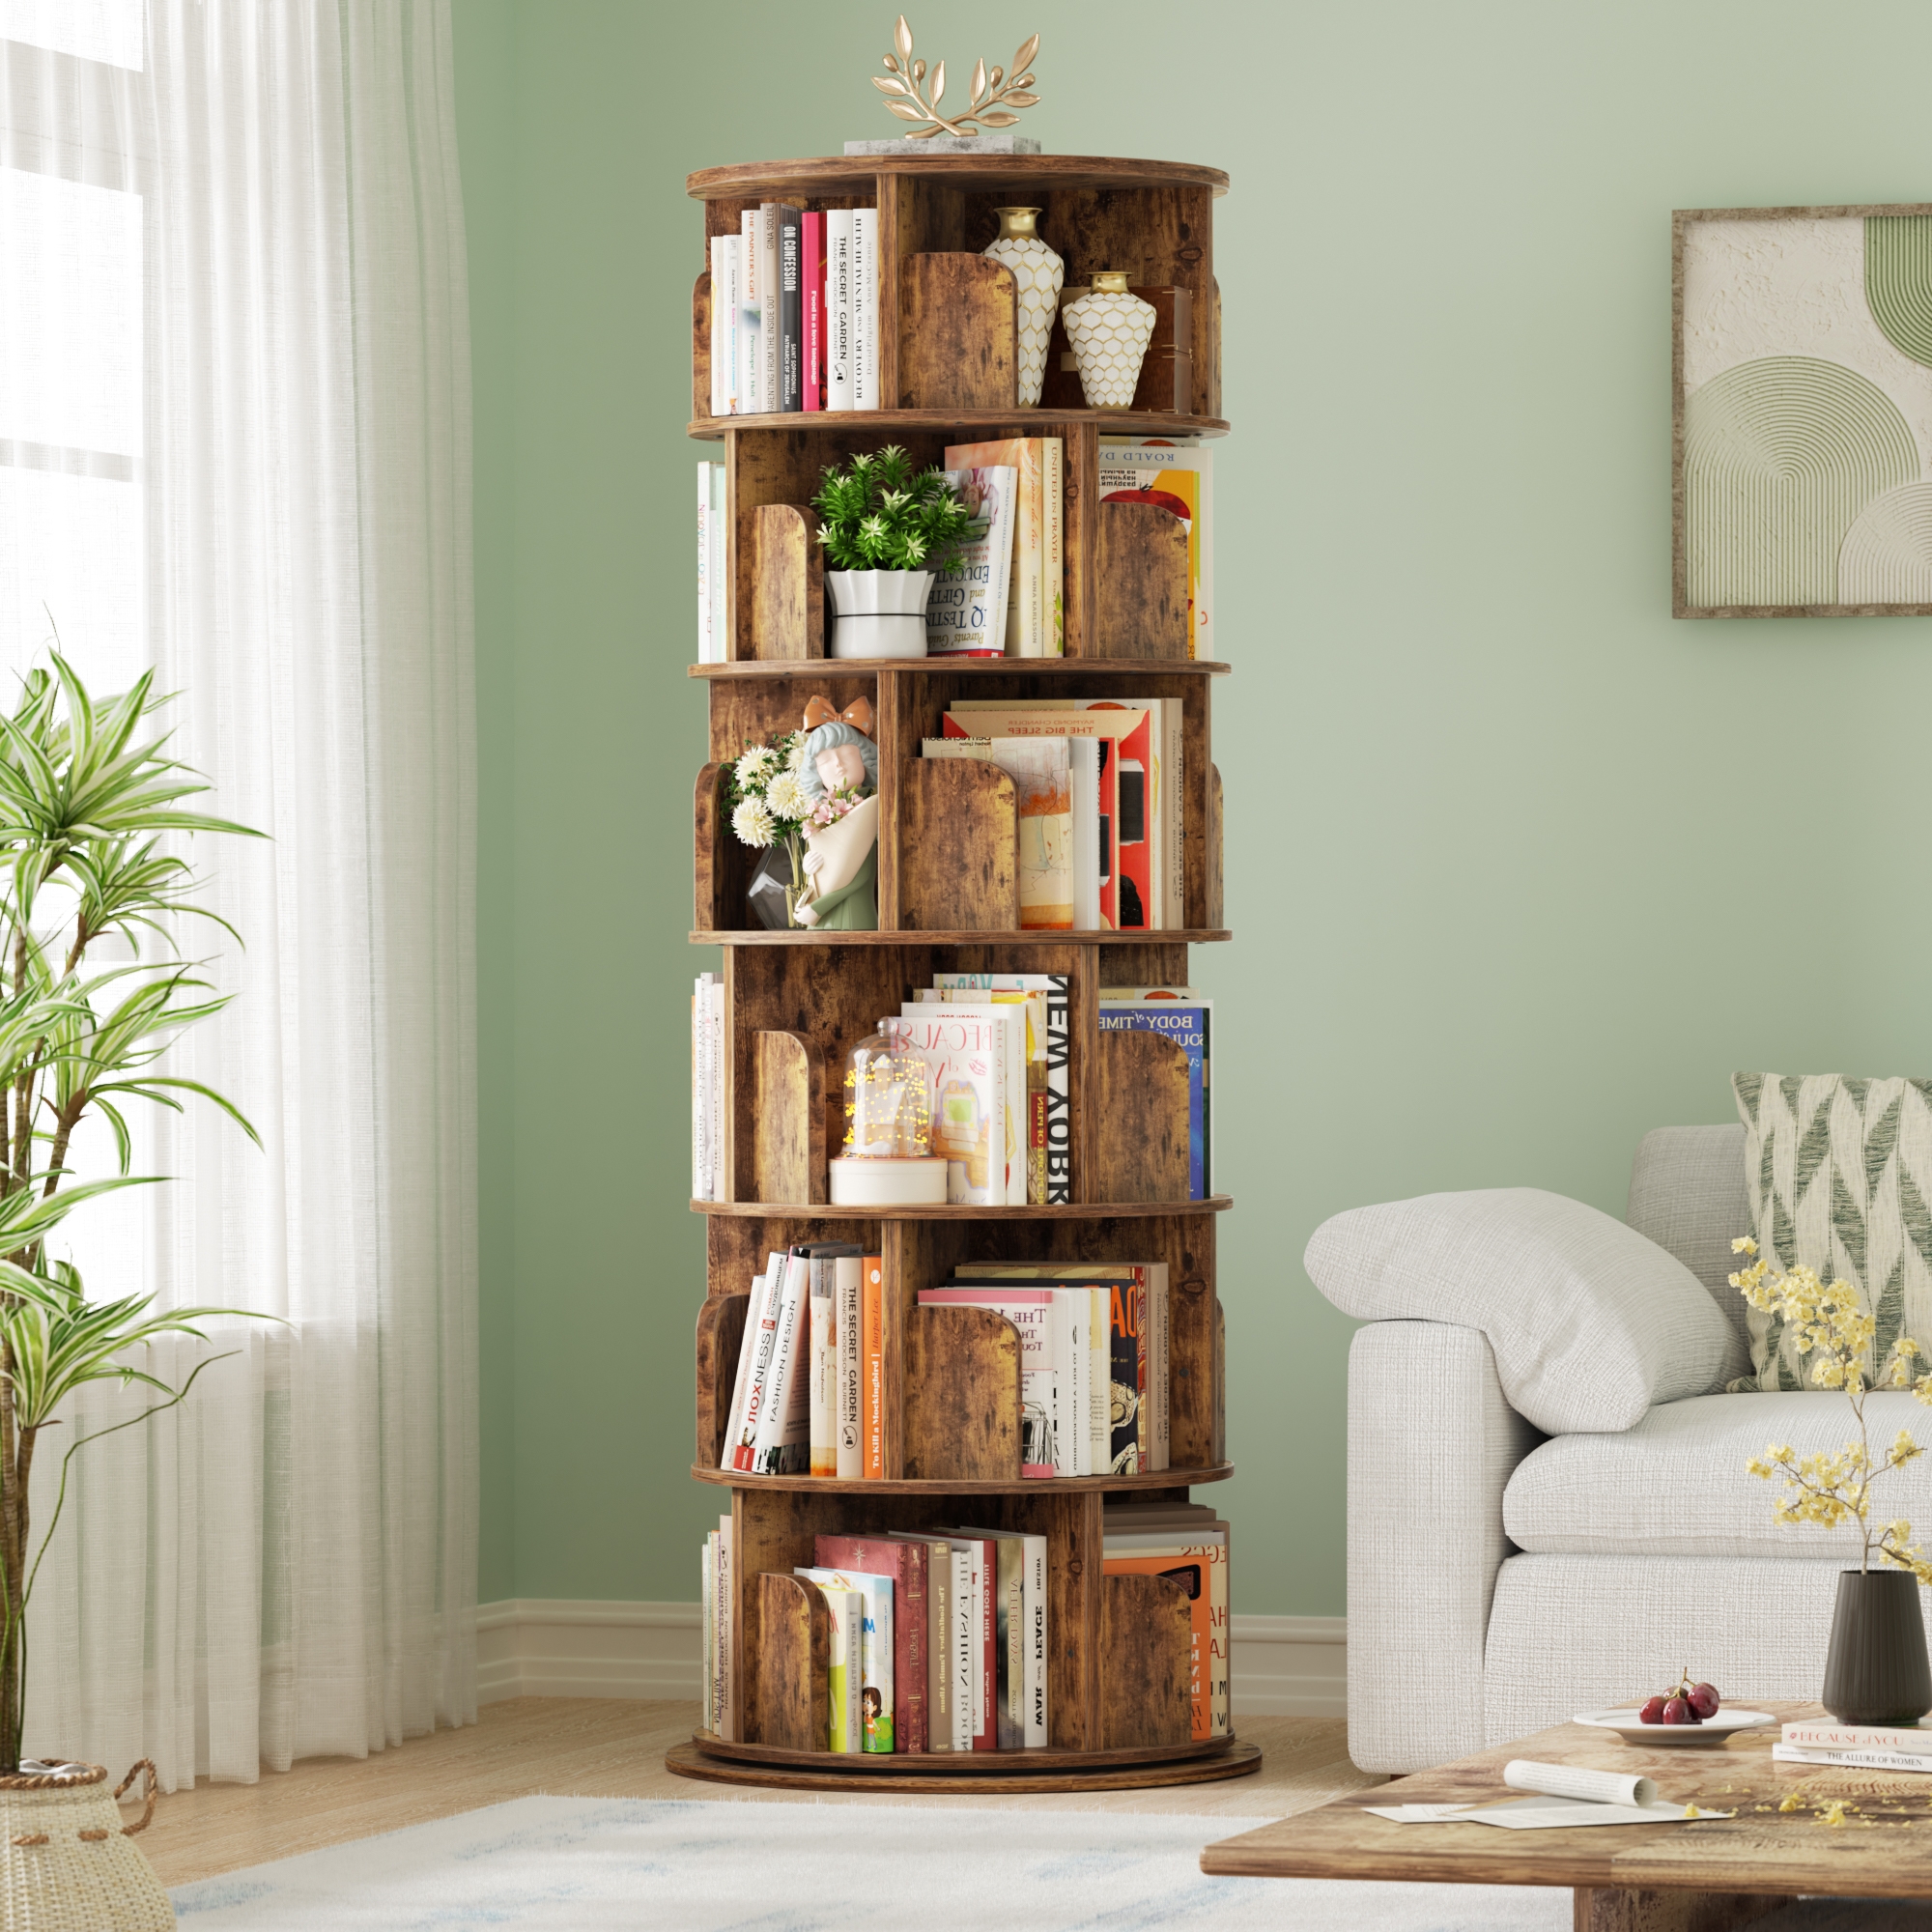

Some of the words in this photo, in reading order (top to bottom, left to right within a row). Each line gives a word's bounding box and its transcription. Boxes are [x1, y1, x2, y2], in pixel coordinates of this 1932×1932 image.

[784, 226, 796, 238] ON
[784, 241, 796, 291] CONFESSION
[1123, 453, 1174, 461] ROALD
[1051, 502, 1057, 514] IN
[928, 589, 964, 606] GIFTE
[970, 589, 985, 602] and
[926, 611, 967, 629] TESTIN
[971, 607, 987, 628] IQ
[952, 632, 984, 647] Parents'
[769, 1358, 786, 1421] FASHION
[781, 1300, 796, 1352] DESIGN
[872, 1455, 879, 1468] To
[1801, 1732, 1860, 1745] BECAUSE
[1863, 1735, 1873, 1744] of
[1874, 1736, 1904, 1746] YOU
[1827, 1752, 1843, 1760] THE
[1845, 1753, 1876, 1763] ALLURE
[1891, 1757, 1922, 1766] WOMEN
